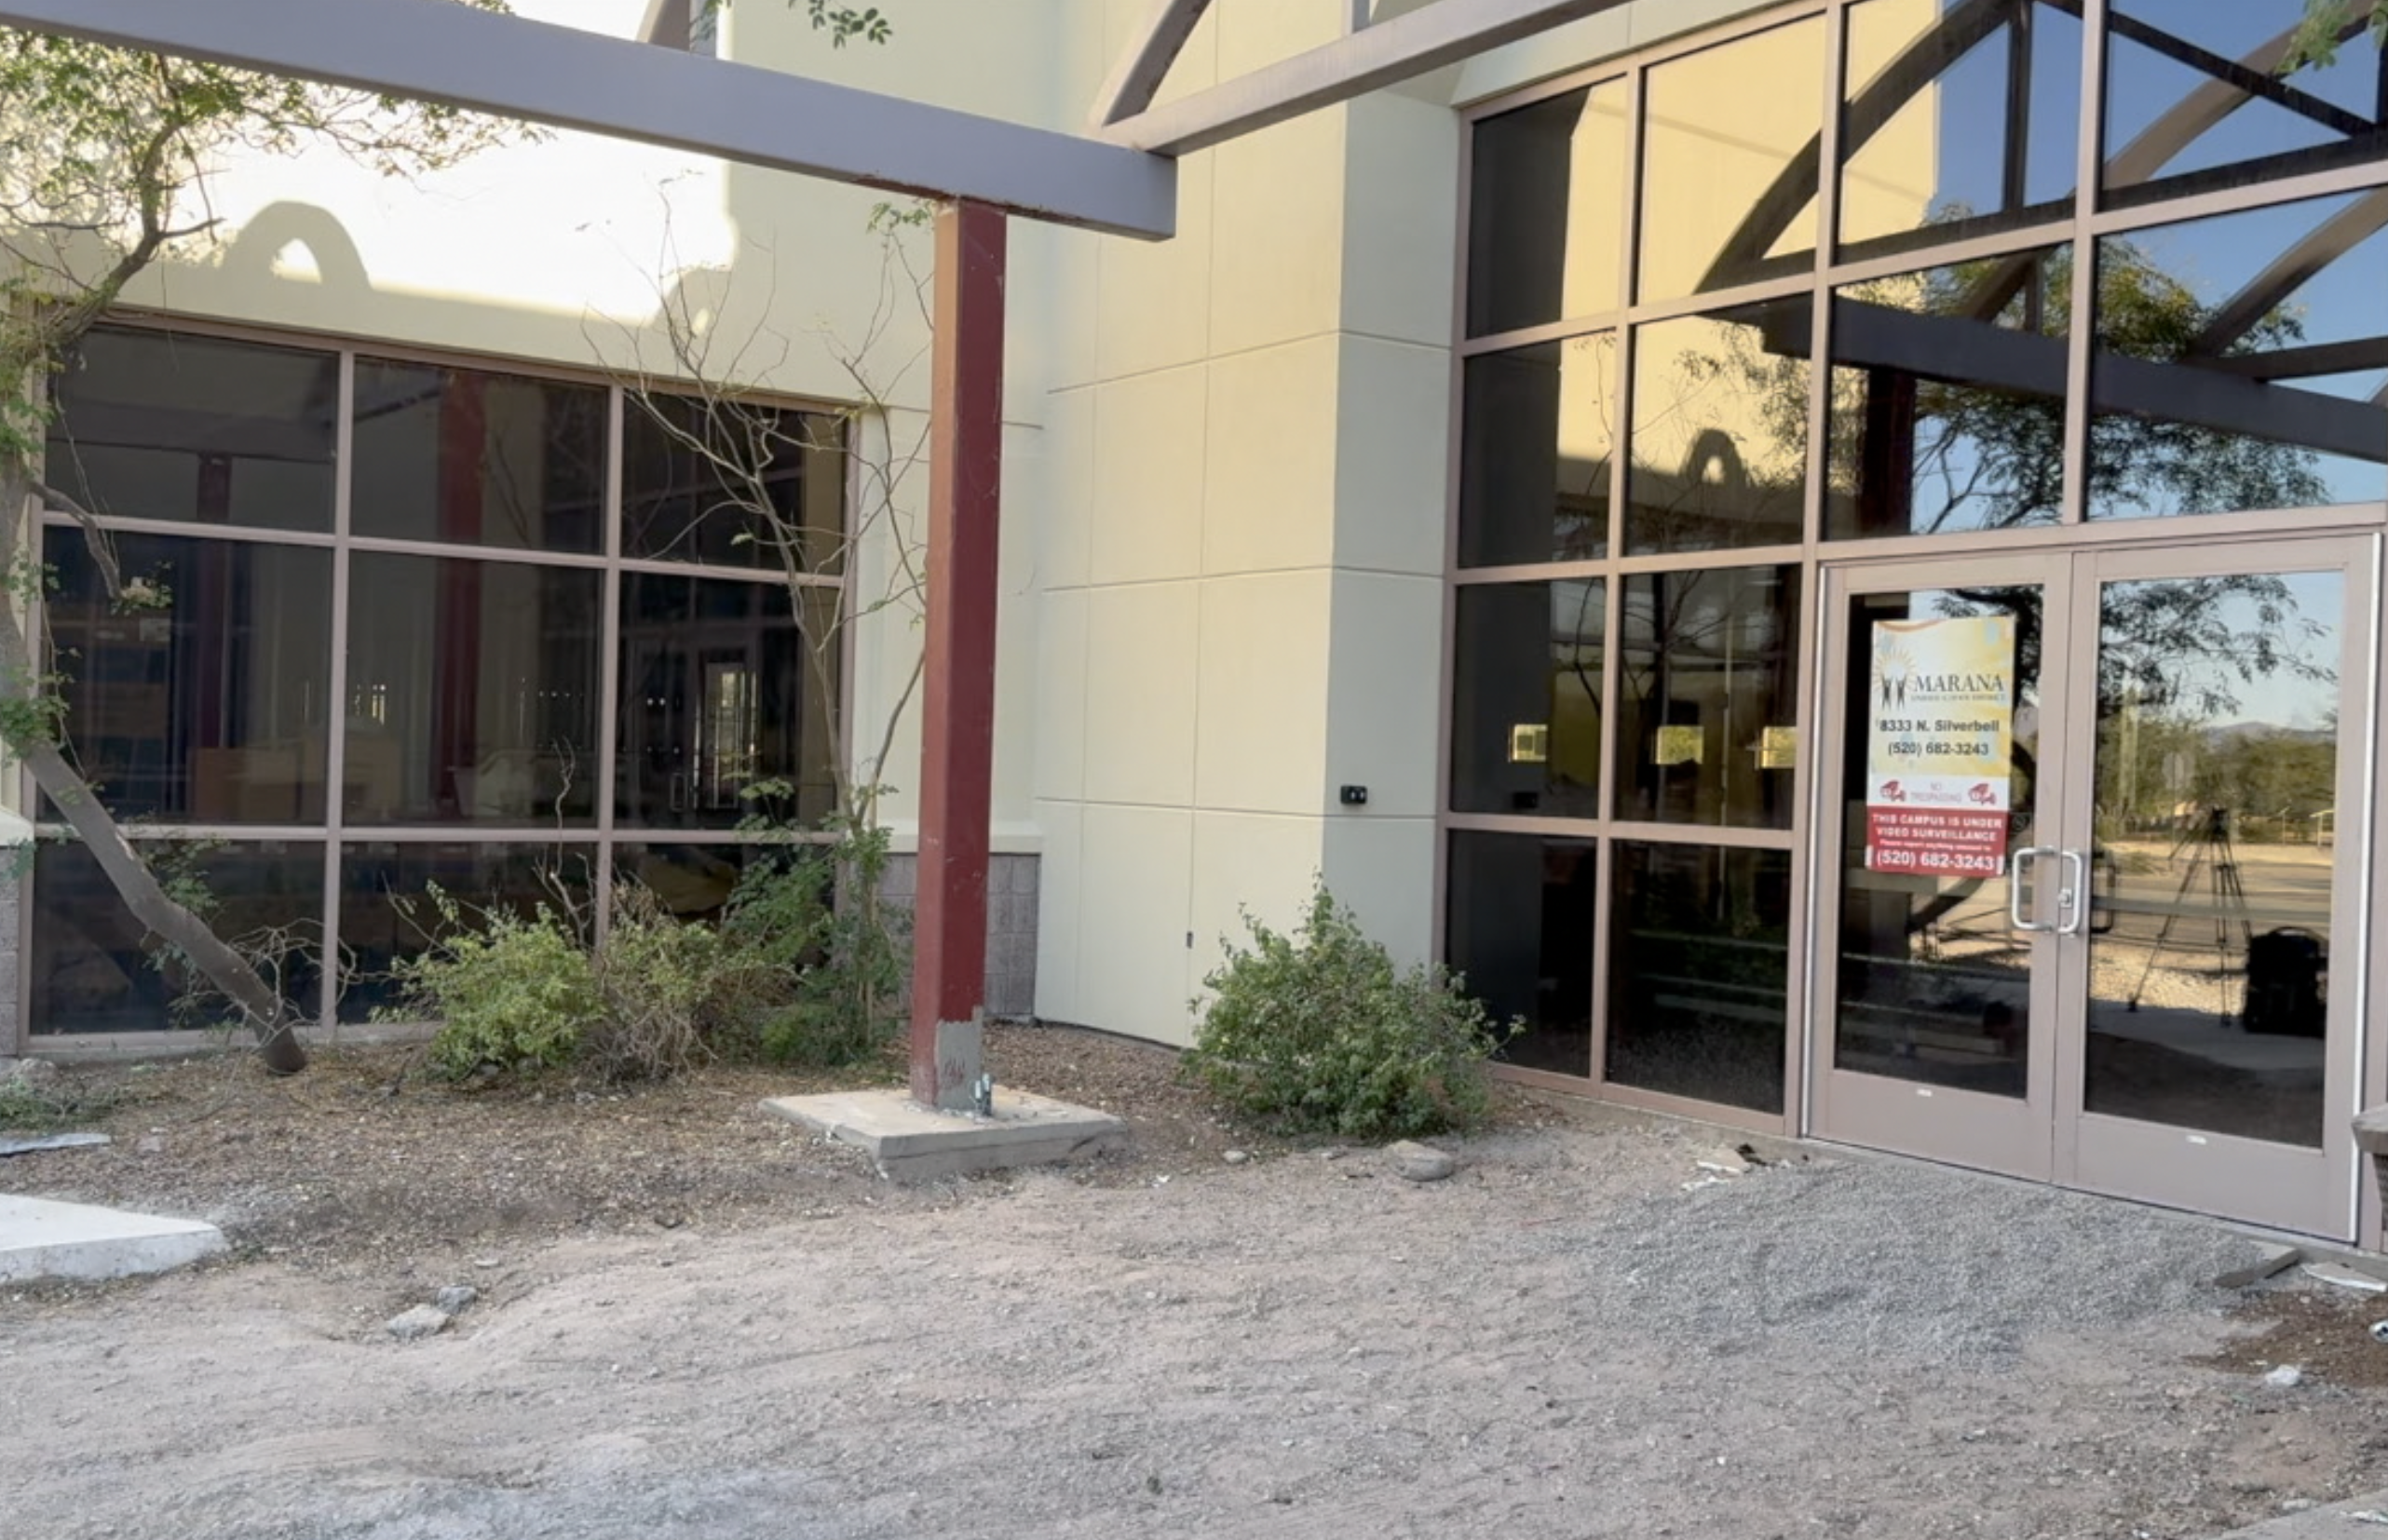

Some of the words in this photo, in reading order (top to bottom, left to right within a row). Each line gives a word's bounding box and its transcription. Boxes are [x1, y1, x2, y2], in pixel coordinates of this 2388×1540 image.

[1915, 674, 2003, 692] MARANA
[1879, 720, 1912, 732] 8333
[1916, 720, 1930, 732] N.
[1934, 720, 2000, 732] Silverbell
[1888, 741, 1922, 757] (520)
[1925, 742, 1989, 756] 682-3243
[1872, 813, 1897, 824] THIS
[1899, 815, 1946, 826] CAMPUS
[1947, 817, 1961, 826] IS
[1962, 817, 2002, 829] UNDER
[1876, 827, 1908, 838] VIDEO
[1911, 828, 1997, 842] SURVEILLANCE
[1878, 850, 1915, 868] (520)
[1920, 852, 1994, 871] 682-3243
